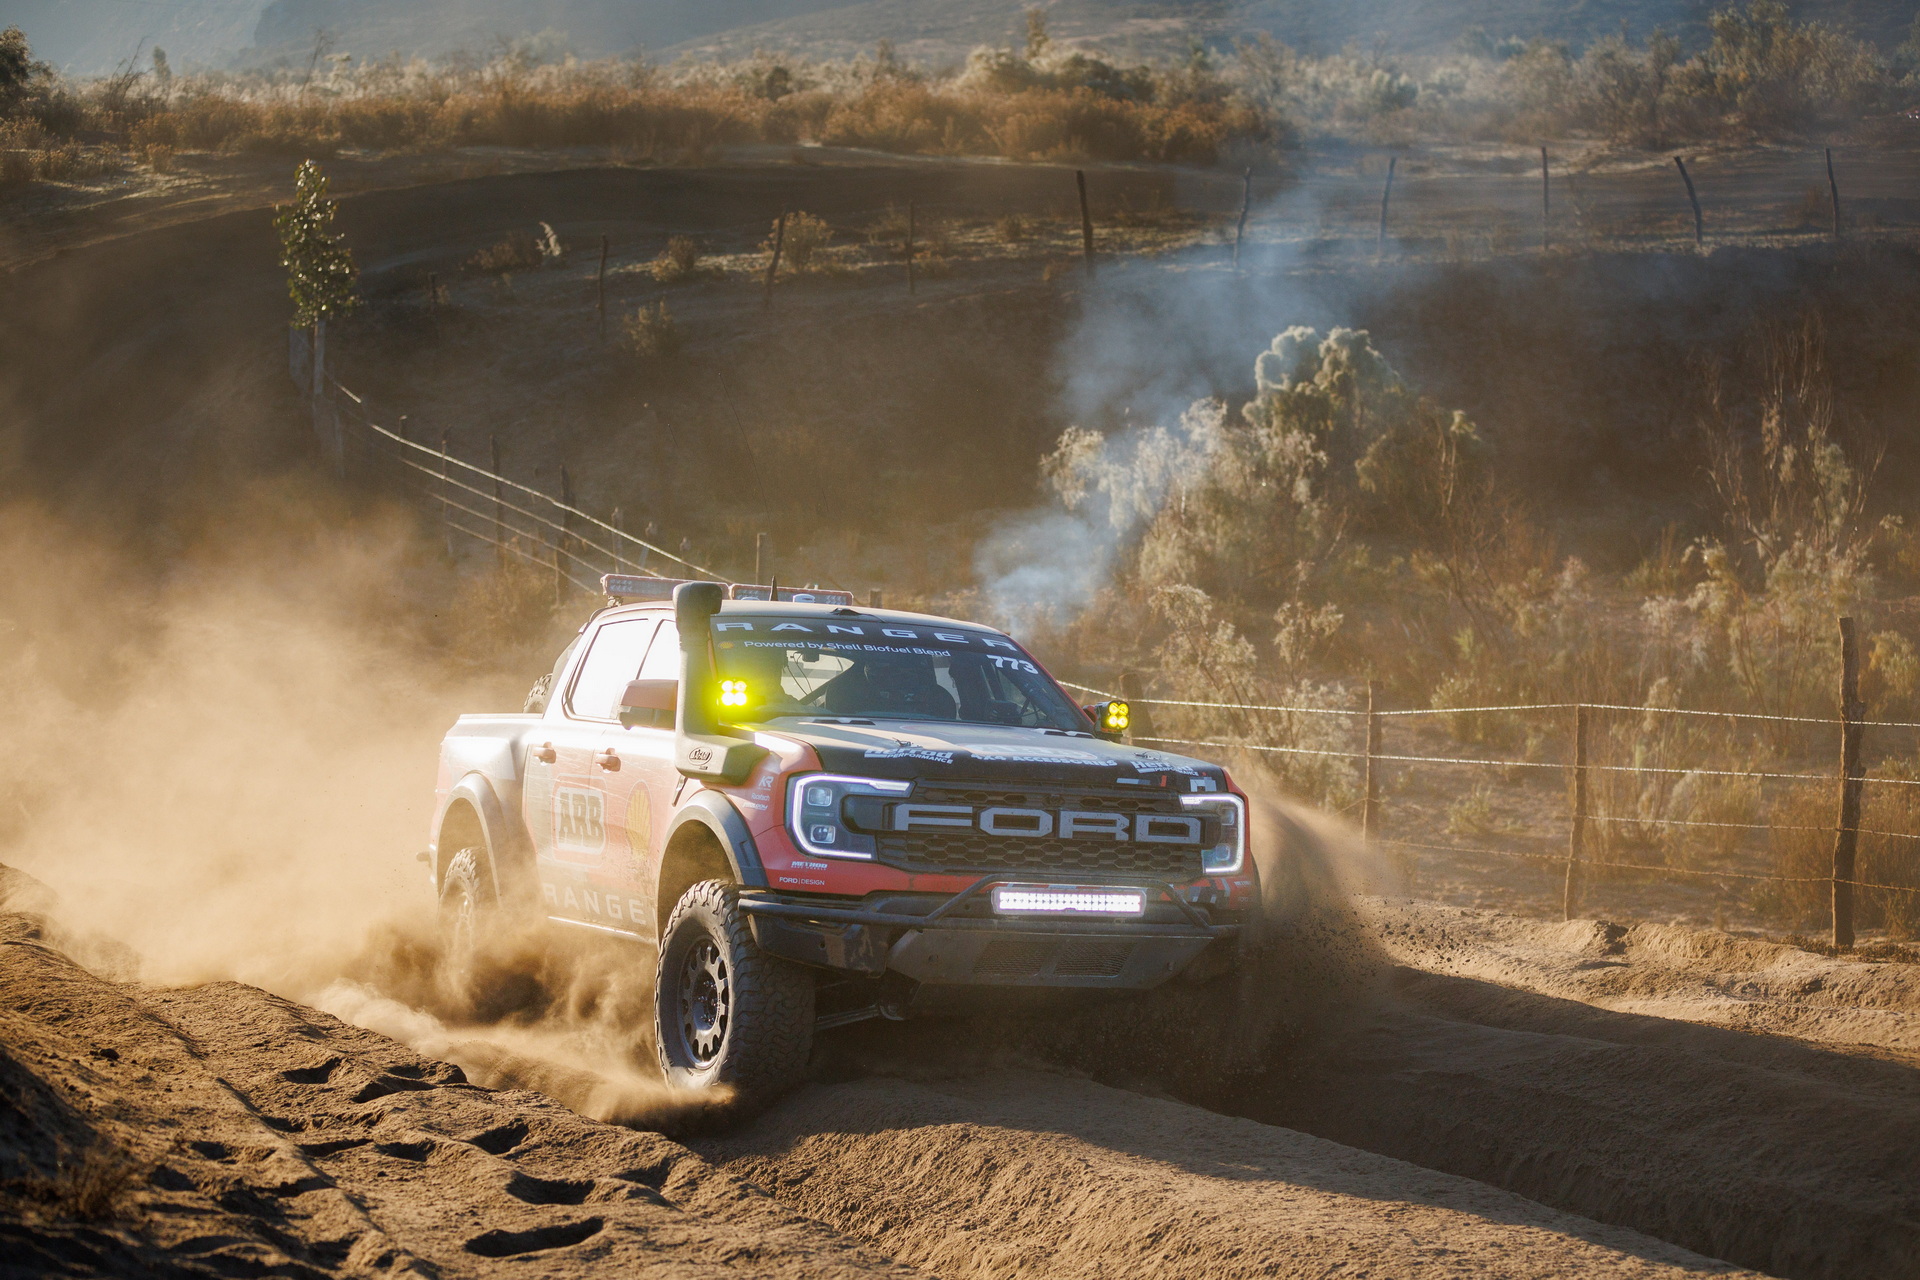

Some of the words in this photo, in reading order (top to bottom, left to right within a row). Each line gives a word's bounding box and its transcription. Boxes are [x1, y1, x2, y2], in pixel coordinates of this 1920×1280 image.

[716, 622, 1018, 652] RANGER
[743, 641, 805, 649] Powered
[807, 641, 824, 651] by
[826, 643, 861, 651] Shell
[863, 645, 911, 654] Biofuel
[914, 648, 951, 657] Blend
[986, 654, 1039, 675] 773
[887, 752, 954, 765] PERFORMANCE
[1013, 756, 1118, 767] ACCESSORIES
[559, 792, 604, 848] ARB
[894, 803, 1201, 844] FORD
[779, 876, 799, 884] FORD
[800, 878, 826, 886] DESIGN
[542, 883, 657, 926] RANGE
